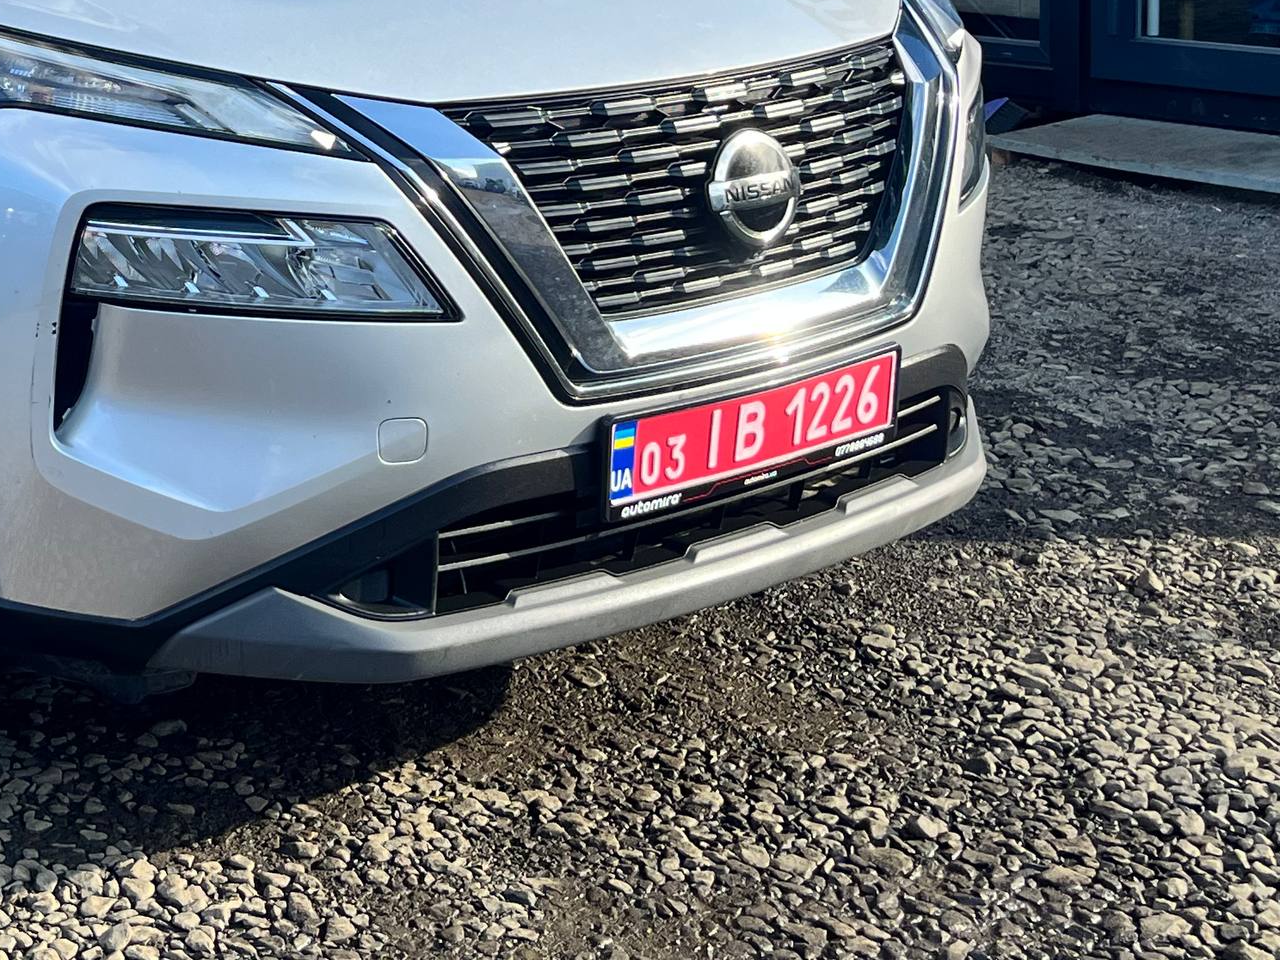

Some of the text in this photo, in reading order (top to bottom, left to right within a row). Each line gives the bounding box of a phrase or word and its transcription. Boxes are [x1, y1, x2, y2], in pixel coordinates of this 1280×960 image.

[725, 177, 793, 203] NISSAN
[640, 364, 880, 486] 03 IB 1226
[611, 468, 632, 492] UA
[621, 493, 680, 518] automira
